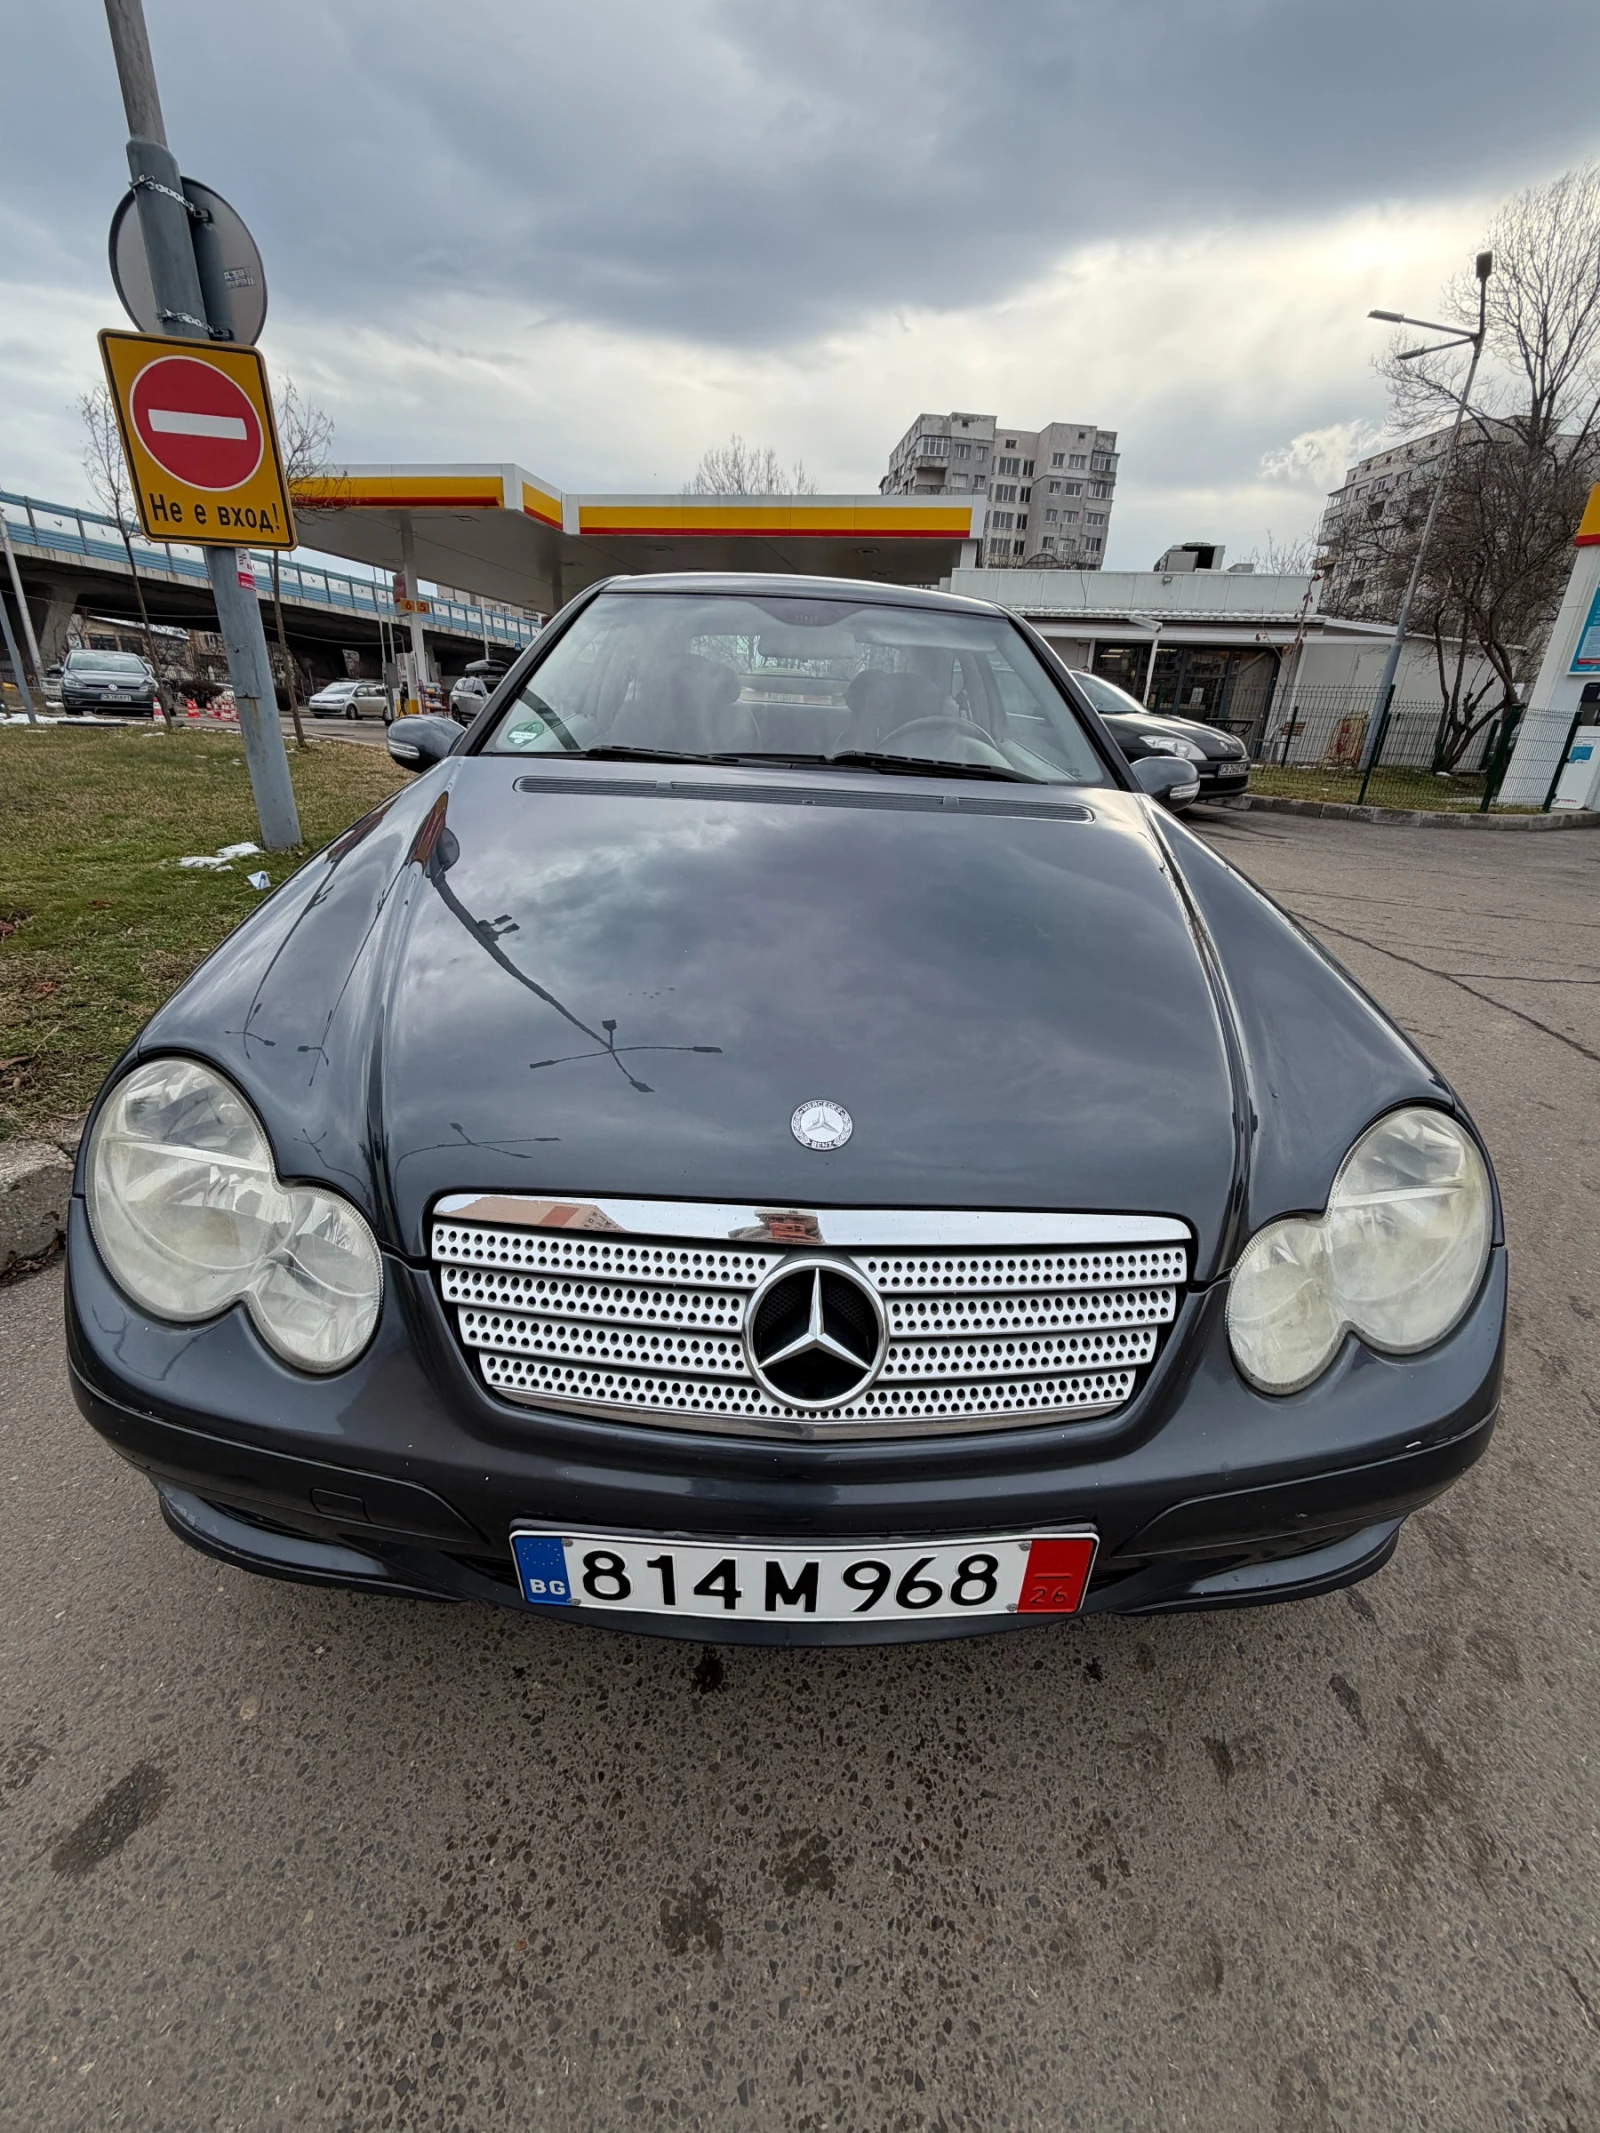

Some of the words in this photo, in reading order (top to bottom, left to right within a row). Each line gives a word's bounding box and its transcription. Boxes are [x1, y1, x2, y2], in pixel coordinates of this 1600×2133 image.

[149, 493, 183, 523] Не
[194, 504, 207, 525] е
[217, 503, 280, 533] вход!
[405, 601, 412, 610] 6
[420, 603, 426, 612] 5
[530, 1578, 566, 1596] BG
[1030, 1586, 1067, 1604] 26
